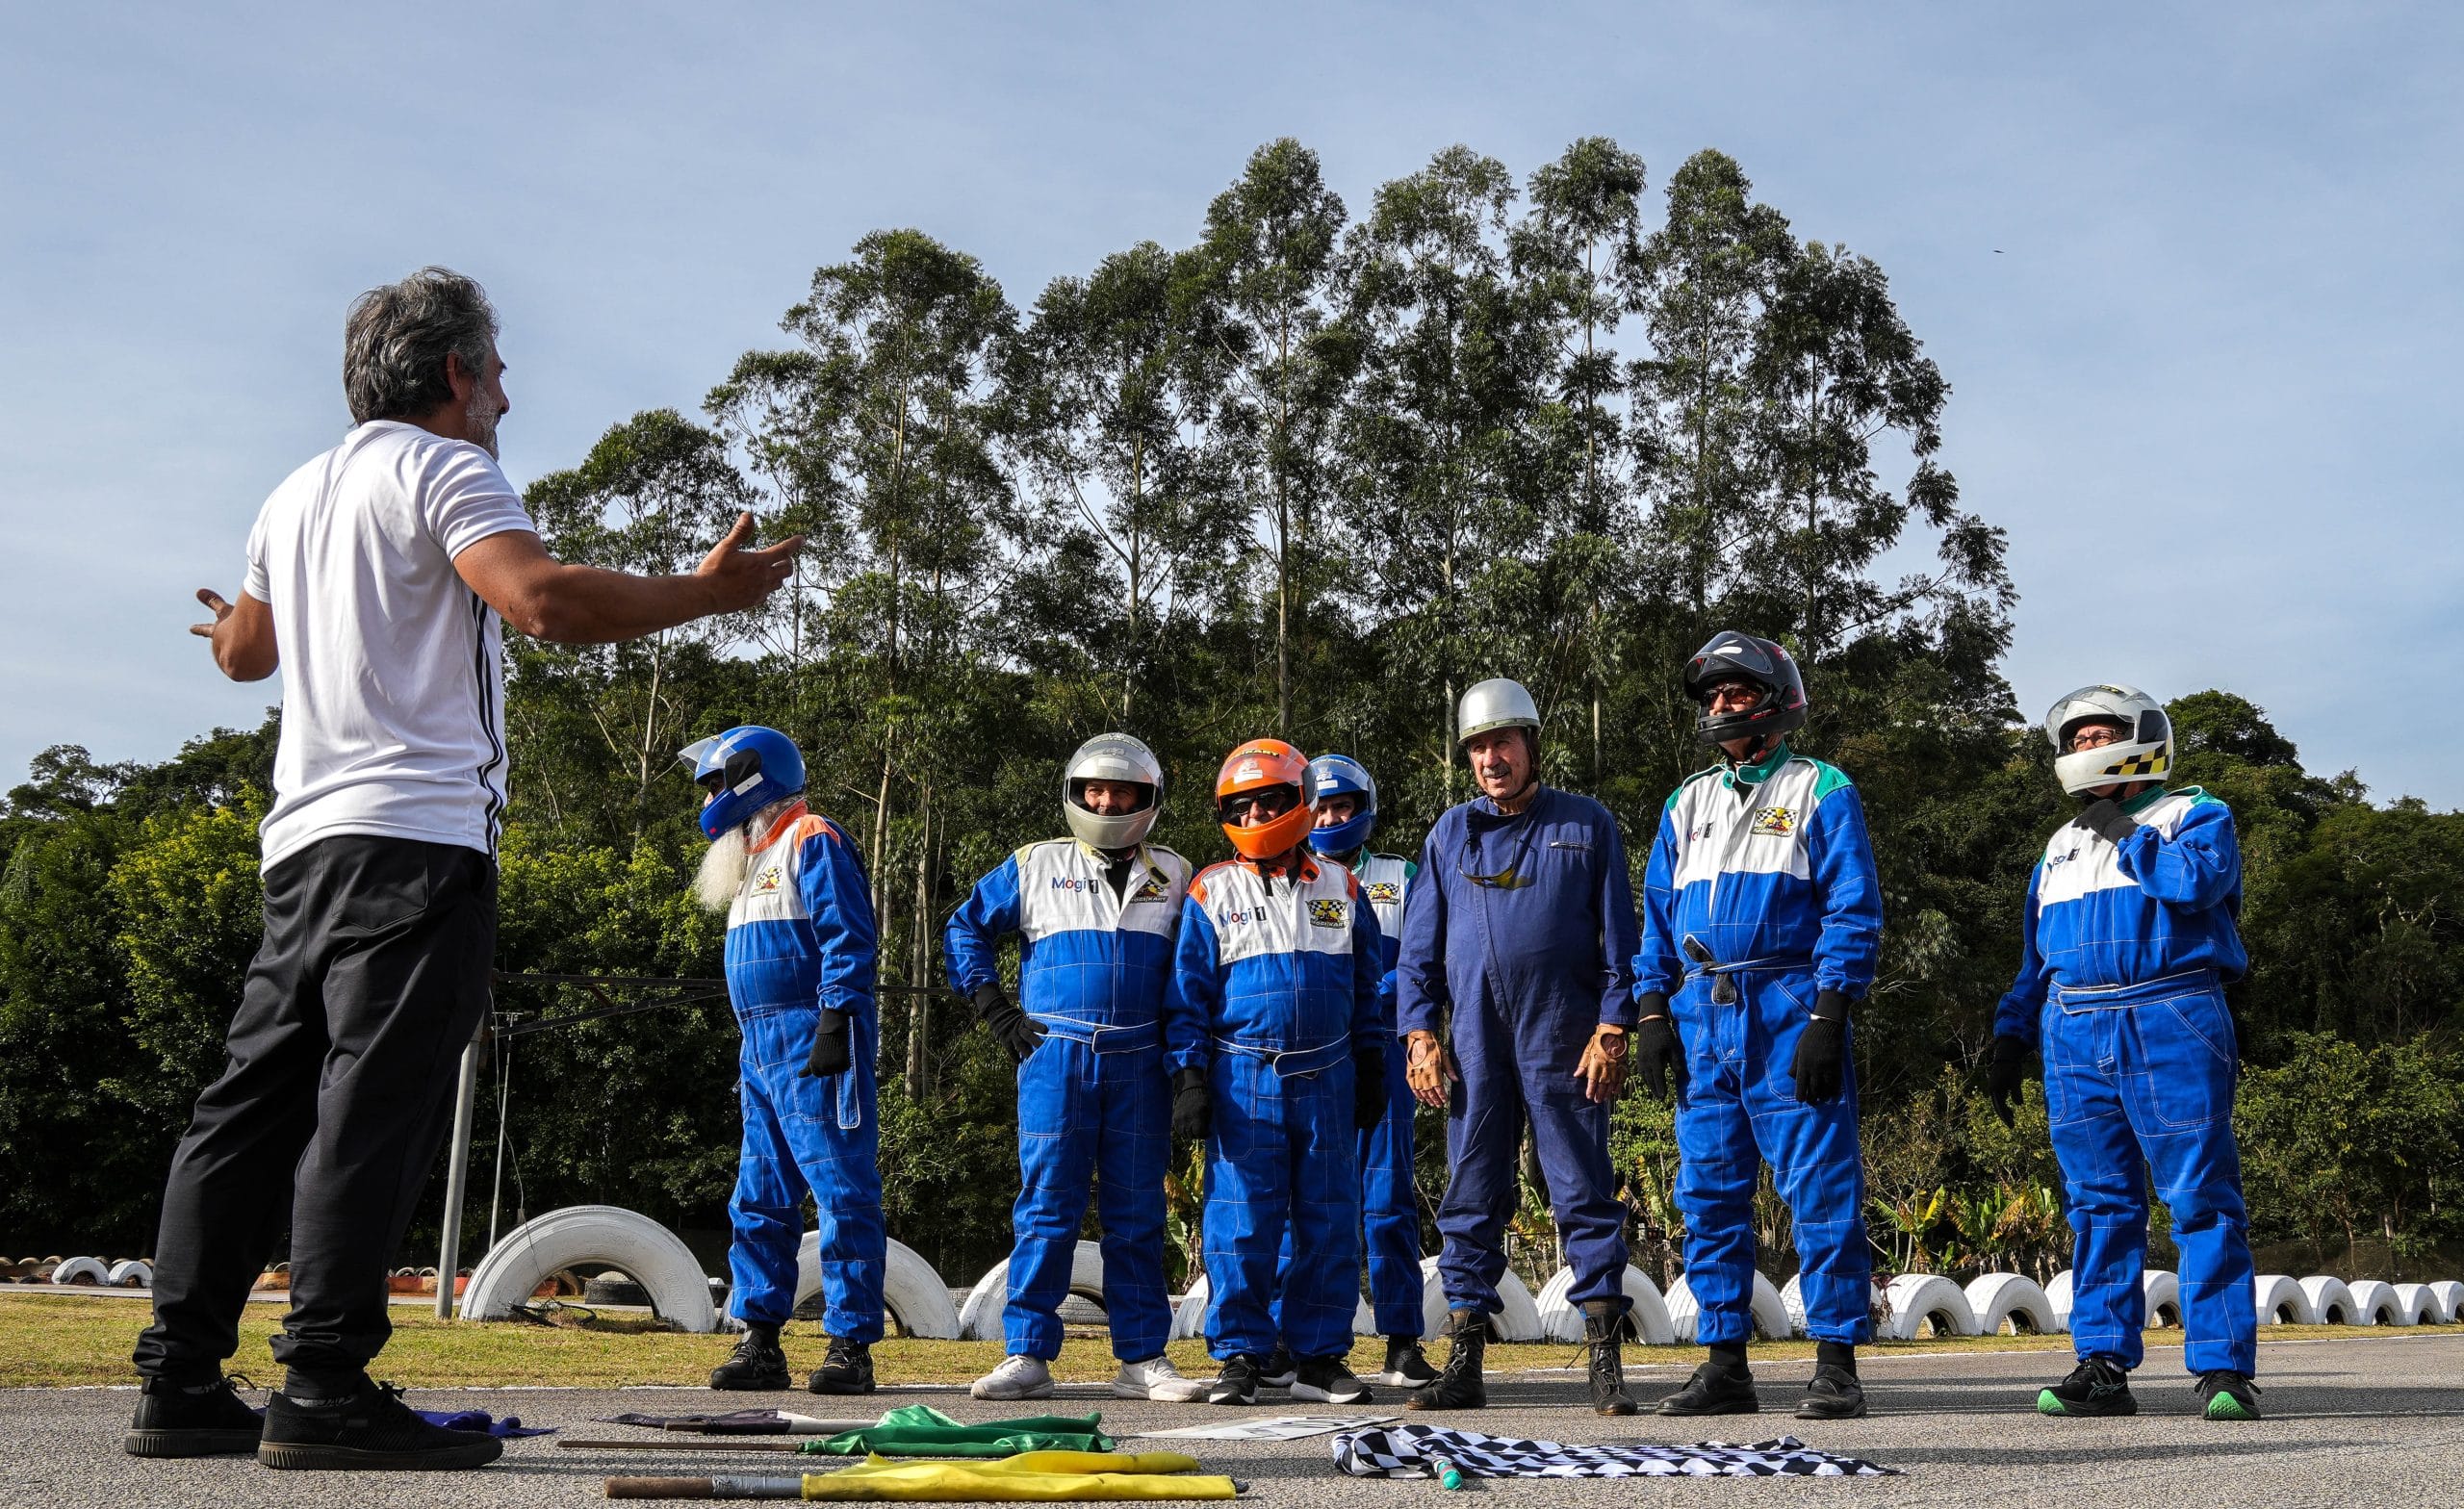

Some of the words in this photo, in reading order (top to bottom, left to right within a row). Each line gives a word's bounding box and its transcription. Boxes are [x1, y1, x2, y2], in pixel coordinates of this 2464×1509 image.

[1051, 877, 1087, 893] Mogi
[1089, 880, 1098, 893] 1
[1218, 908, 1252, 928] Mogi
[1255, 907, 1267, 921] 1
